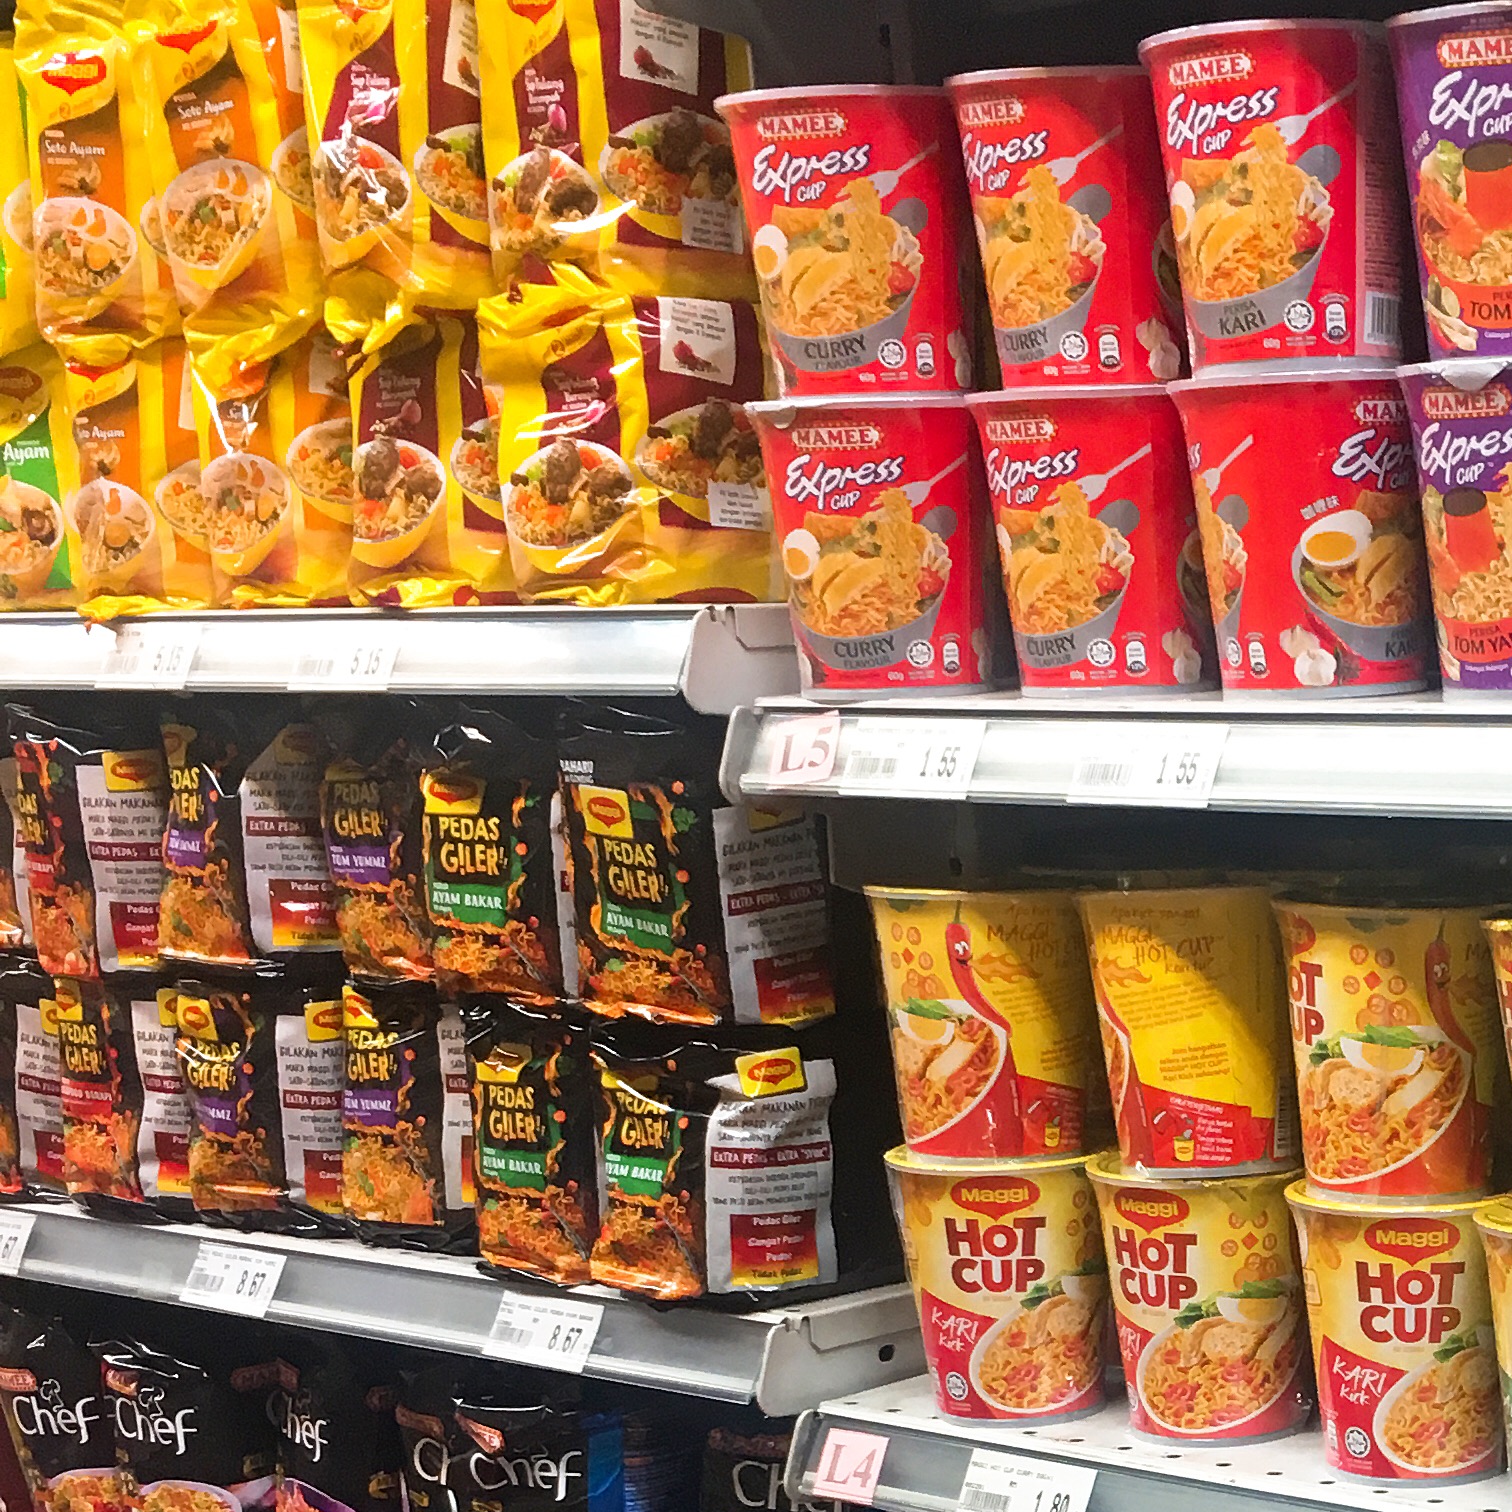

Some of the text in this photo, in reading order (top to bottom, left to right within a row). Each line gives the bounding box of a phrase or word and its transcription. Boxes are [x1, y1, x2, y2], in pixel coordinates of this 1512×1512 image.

[760, 117, 842, 135] MAMEE
[752, 144, 871, 203] Express
[1217, 310, 1267, 336] KARI
[804, 339, 868, 361] CURRY
[797, 427, 874, 447] MAMEE
[2, 442, 50, 465] Ayam
[784, 454, 904, 511] Express
[834, 634, 896, 658] CURRY
[781, 727, 834, 773] L5
[919, 746, 961, 779] 1.55
[1156, 752, 1200, 786] 1.55
[439, 816, 500, 841] PEDAS
[604, 839, 657, 863] PEDAS
[433, 893, 503, 910] AYAM BAKAR
[61, 1022, 98, 1044] PEDAS
[489, 1083, 535, 1110] PEDAS
[509, 1157, 542, 1175] BAKAR
[632, 1165, 664, 1183] BAKAR
[944, 1217, 1047, 1258] HOT
[236, 1270, 266, 1298] 8.67
[1355, 1262, 1466, 1305] HOT
[549, 1324, 583, 1351] 8.67
[1359, 1306, 1462, 1345] CUP
[1332, 1356, 1388, 1398] KARI
[13, 1396, 99, 1443] Chef
[115, 1398, 198, 1455] Chef
[469, 1449, 583, 1501] Chef
[824, 1443, 872, 1490] L4
